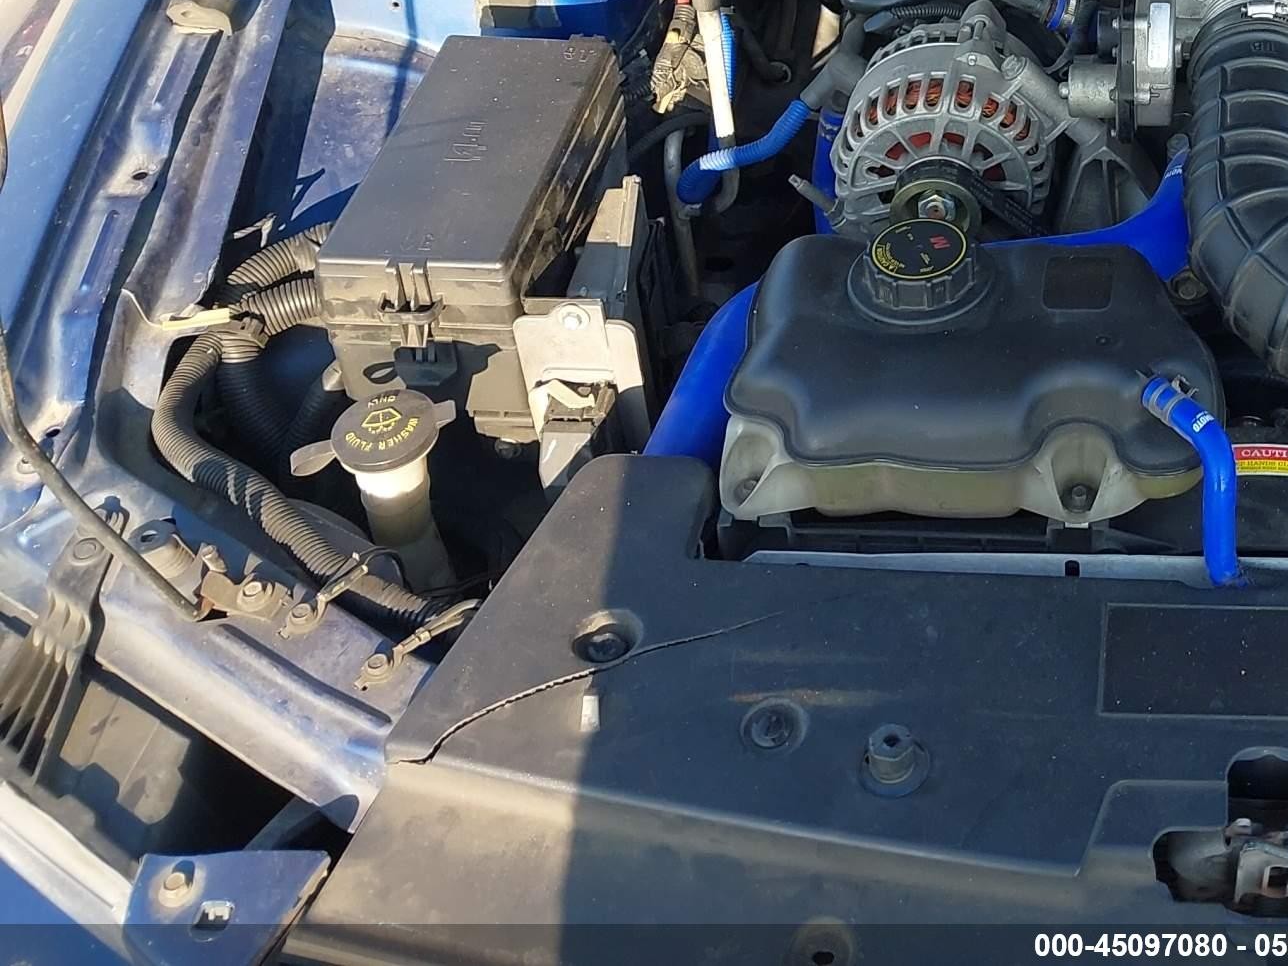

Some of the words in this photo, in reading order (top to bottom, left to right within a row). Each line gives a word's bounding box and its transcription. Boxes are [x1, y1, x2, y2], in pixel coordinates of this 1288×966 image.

[367, 395, 397, 409] ONLY
[345, 431, 374, 452] FLUID
[378, 417, 419, 451] WASHER
